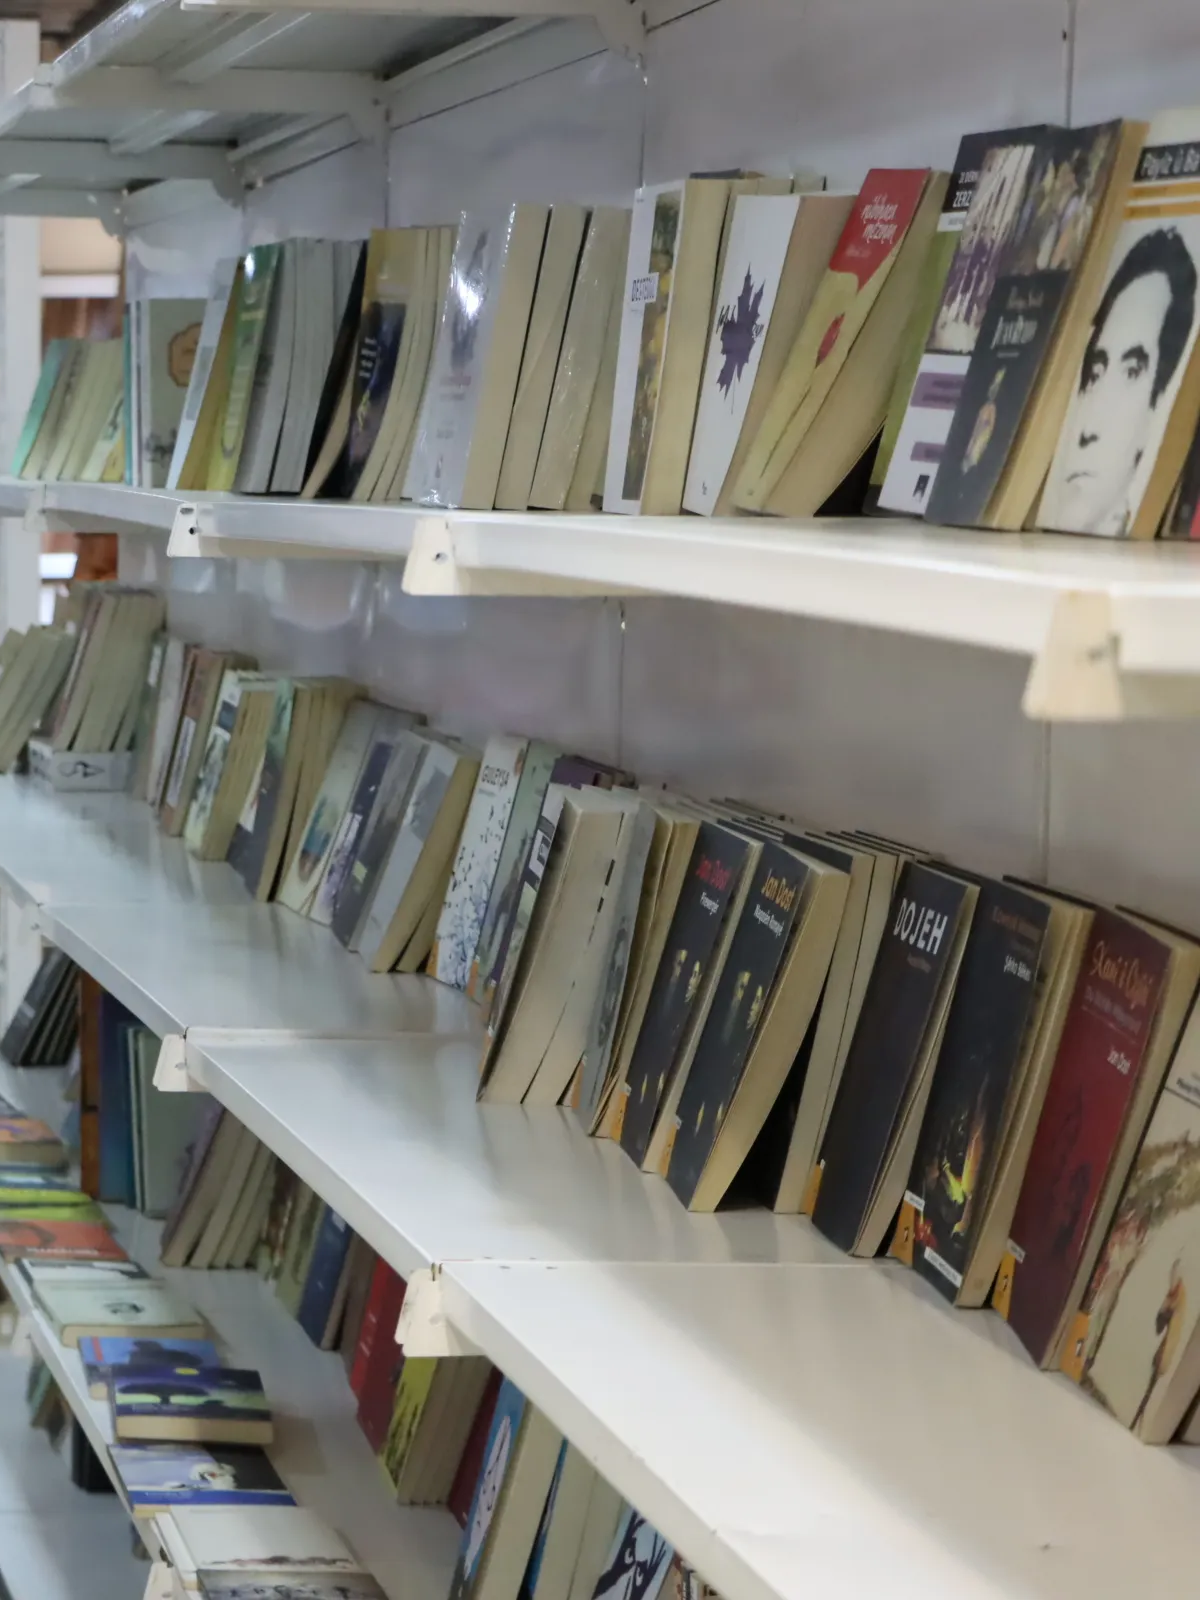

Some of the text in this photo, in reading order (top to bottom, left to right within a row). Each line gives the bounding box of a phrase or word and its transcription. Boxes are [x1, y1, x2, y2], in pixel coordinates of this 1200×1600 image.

[761, 868, 797, 912] Jan Dost
[893, 897, 949, 955] DOJEH
